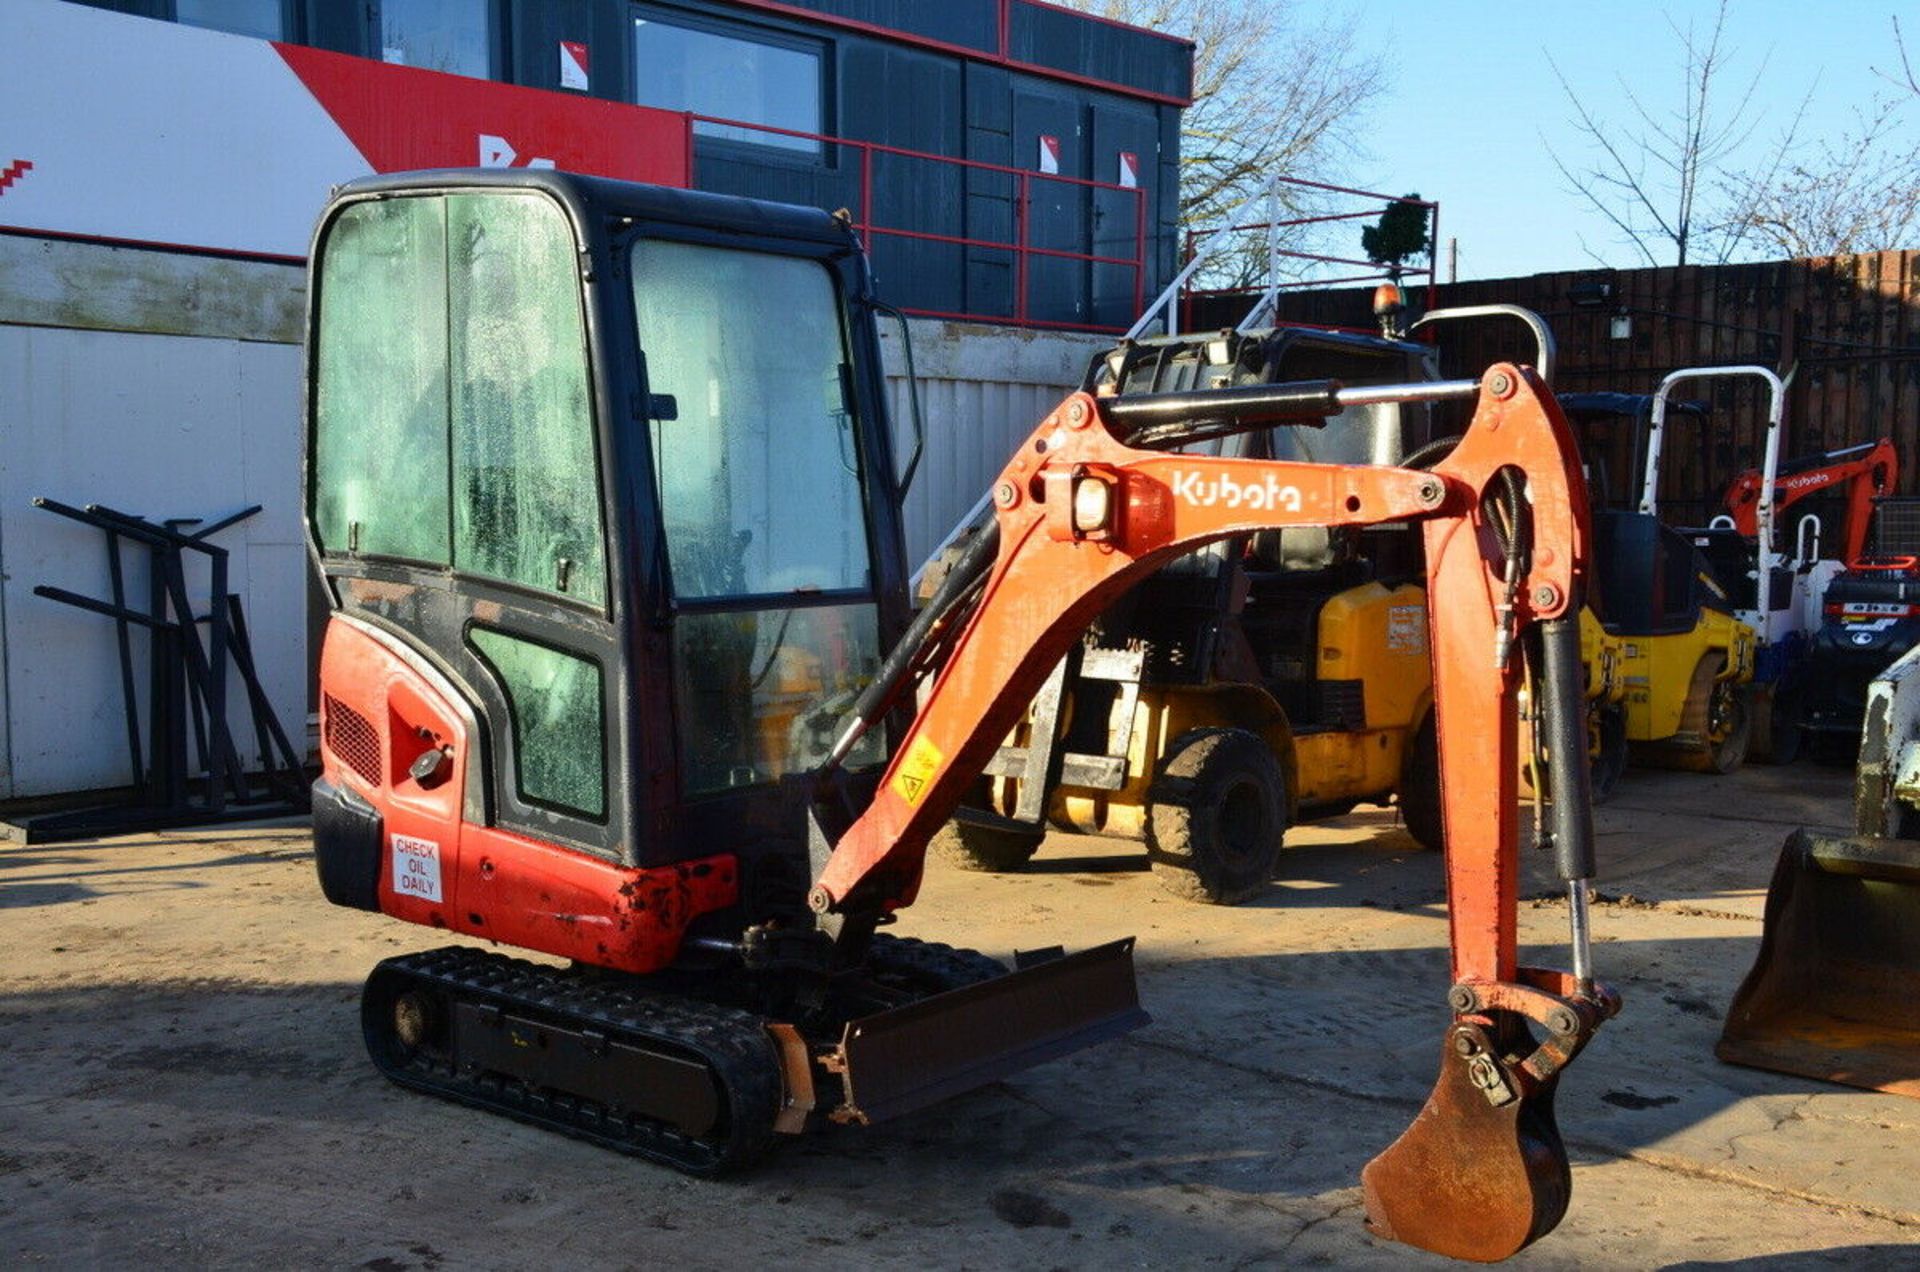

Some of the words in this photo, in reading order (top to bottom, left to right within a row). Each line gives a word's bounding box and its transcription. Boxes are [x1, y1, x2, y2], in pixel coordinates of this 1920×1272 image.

[1172, 470, 1302, 512] Kubota
[397, 839, 435, 860] CHECK
[408, 858, 426, 875] OIL
[402, 875, 434, 894] DAILY
